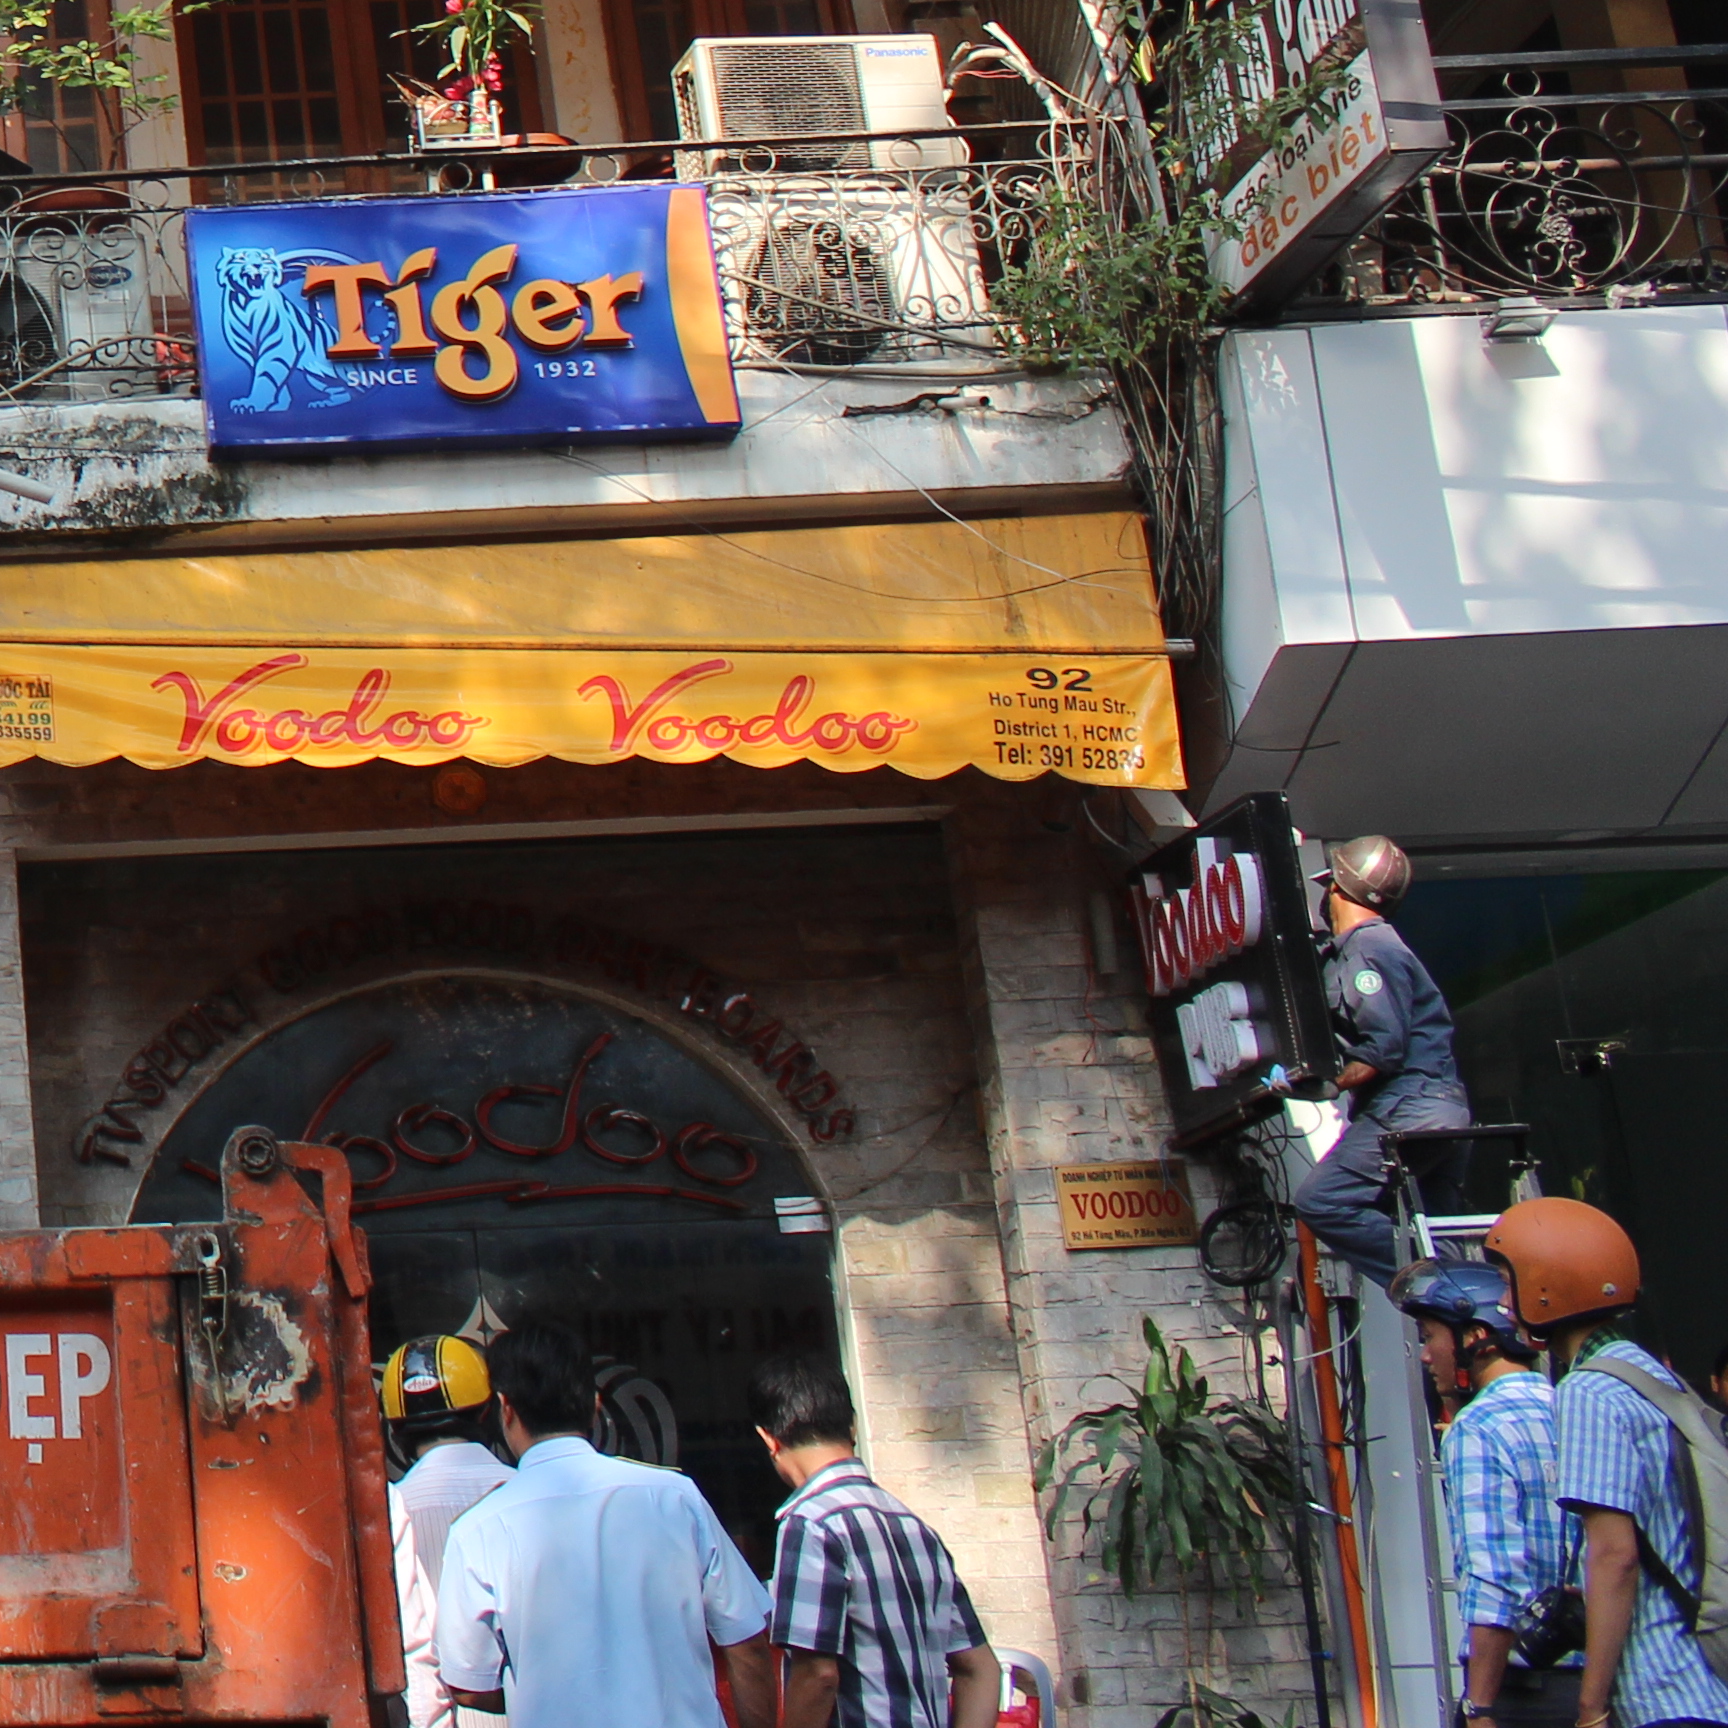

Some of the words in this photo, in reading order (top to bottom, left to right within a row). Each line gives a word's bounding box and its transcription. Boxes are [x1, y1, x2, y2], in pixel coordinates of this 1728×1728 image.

[1306, 111, 1377, 200] biệt
[347, 367, 418, 387] SINCE
[534, 360, 596, 379] 1932
[1026, 667, 1093, 692] 92
[150, 653, 491, 756] Voodoo
[577, 658, 921, 756] Voodoo
[989, 692, 1012, 707] Ho
[1016, 693, 1059, 713] Tung
[1064, 696, 1097, 712] Mau
[994, 719, 1057, 738] District
[1064, 725, 1078, 743] 1,
[1083, 725, 1138, 742] HCMC
[994, 742, 1032, 765] Tel:
[1040, 745, 1073, 768] 391
[1070, 1189, 1181, 1219] VOODOO
